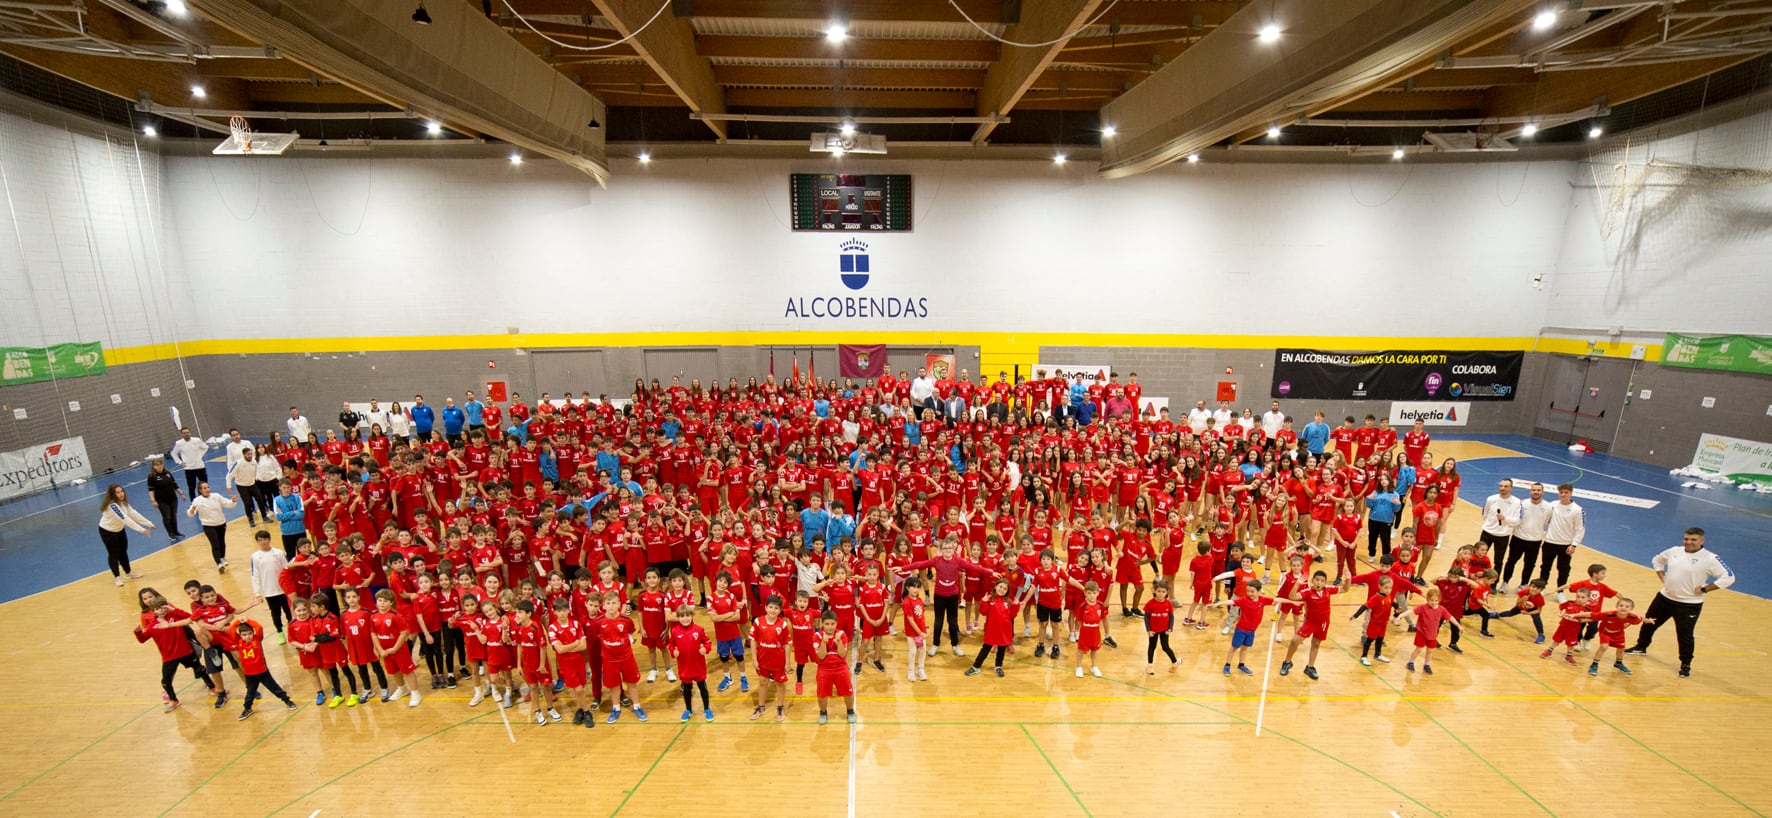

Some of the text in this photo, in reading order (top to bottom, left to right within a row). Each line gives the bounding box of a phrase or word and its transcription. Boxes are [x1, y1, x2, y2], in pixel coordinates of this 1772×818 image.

[785, 297, 928, 318] ALCOBENDAS
[1281, 353, 1447, 364] EN ALCOBENDAS DAMOS LA CARA POR TI
[1452, 365, 1497, 374] COLABORA
[1428, 376, 1439, 385] fin
[1400, 410, 1444, 420] helvetia
[1733, 442, 1751, 454] Plan
[1752, 446, 1764, 455] de
[350, 626, 358, 635] 18
[242, 648, 255, 659] 14
